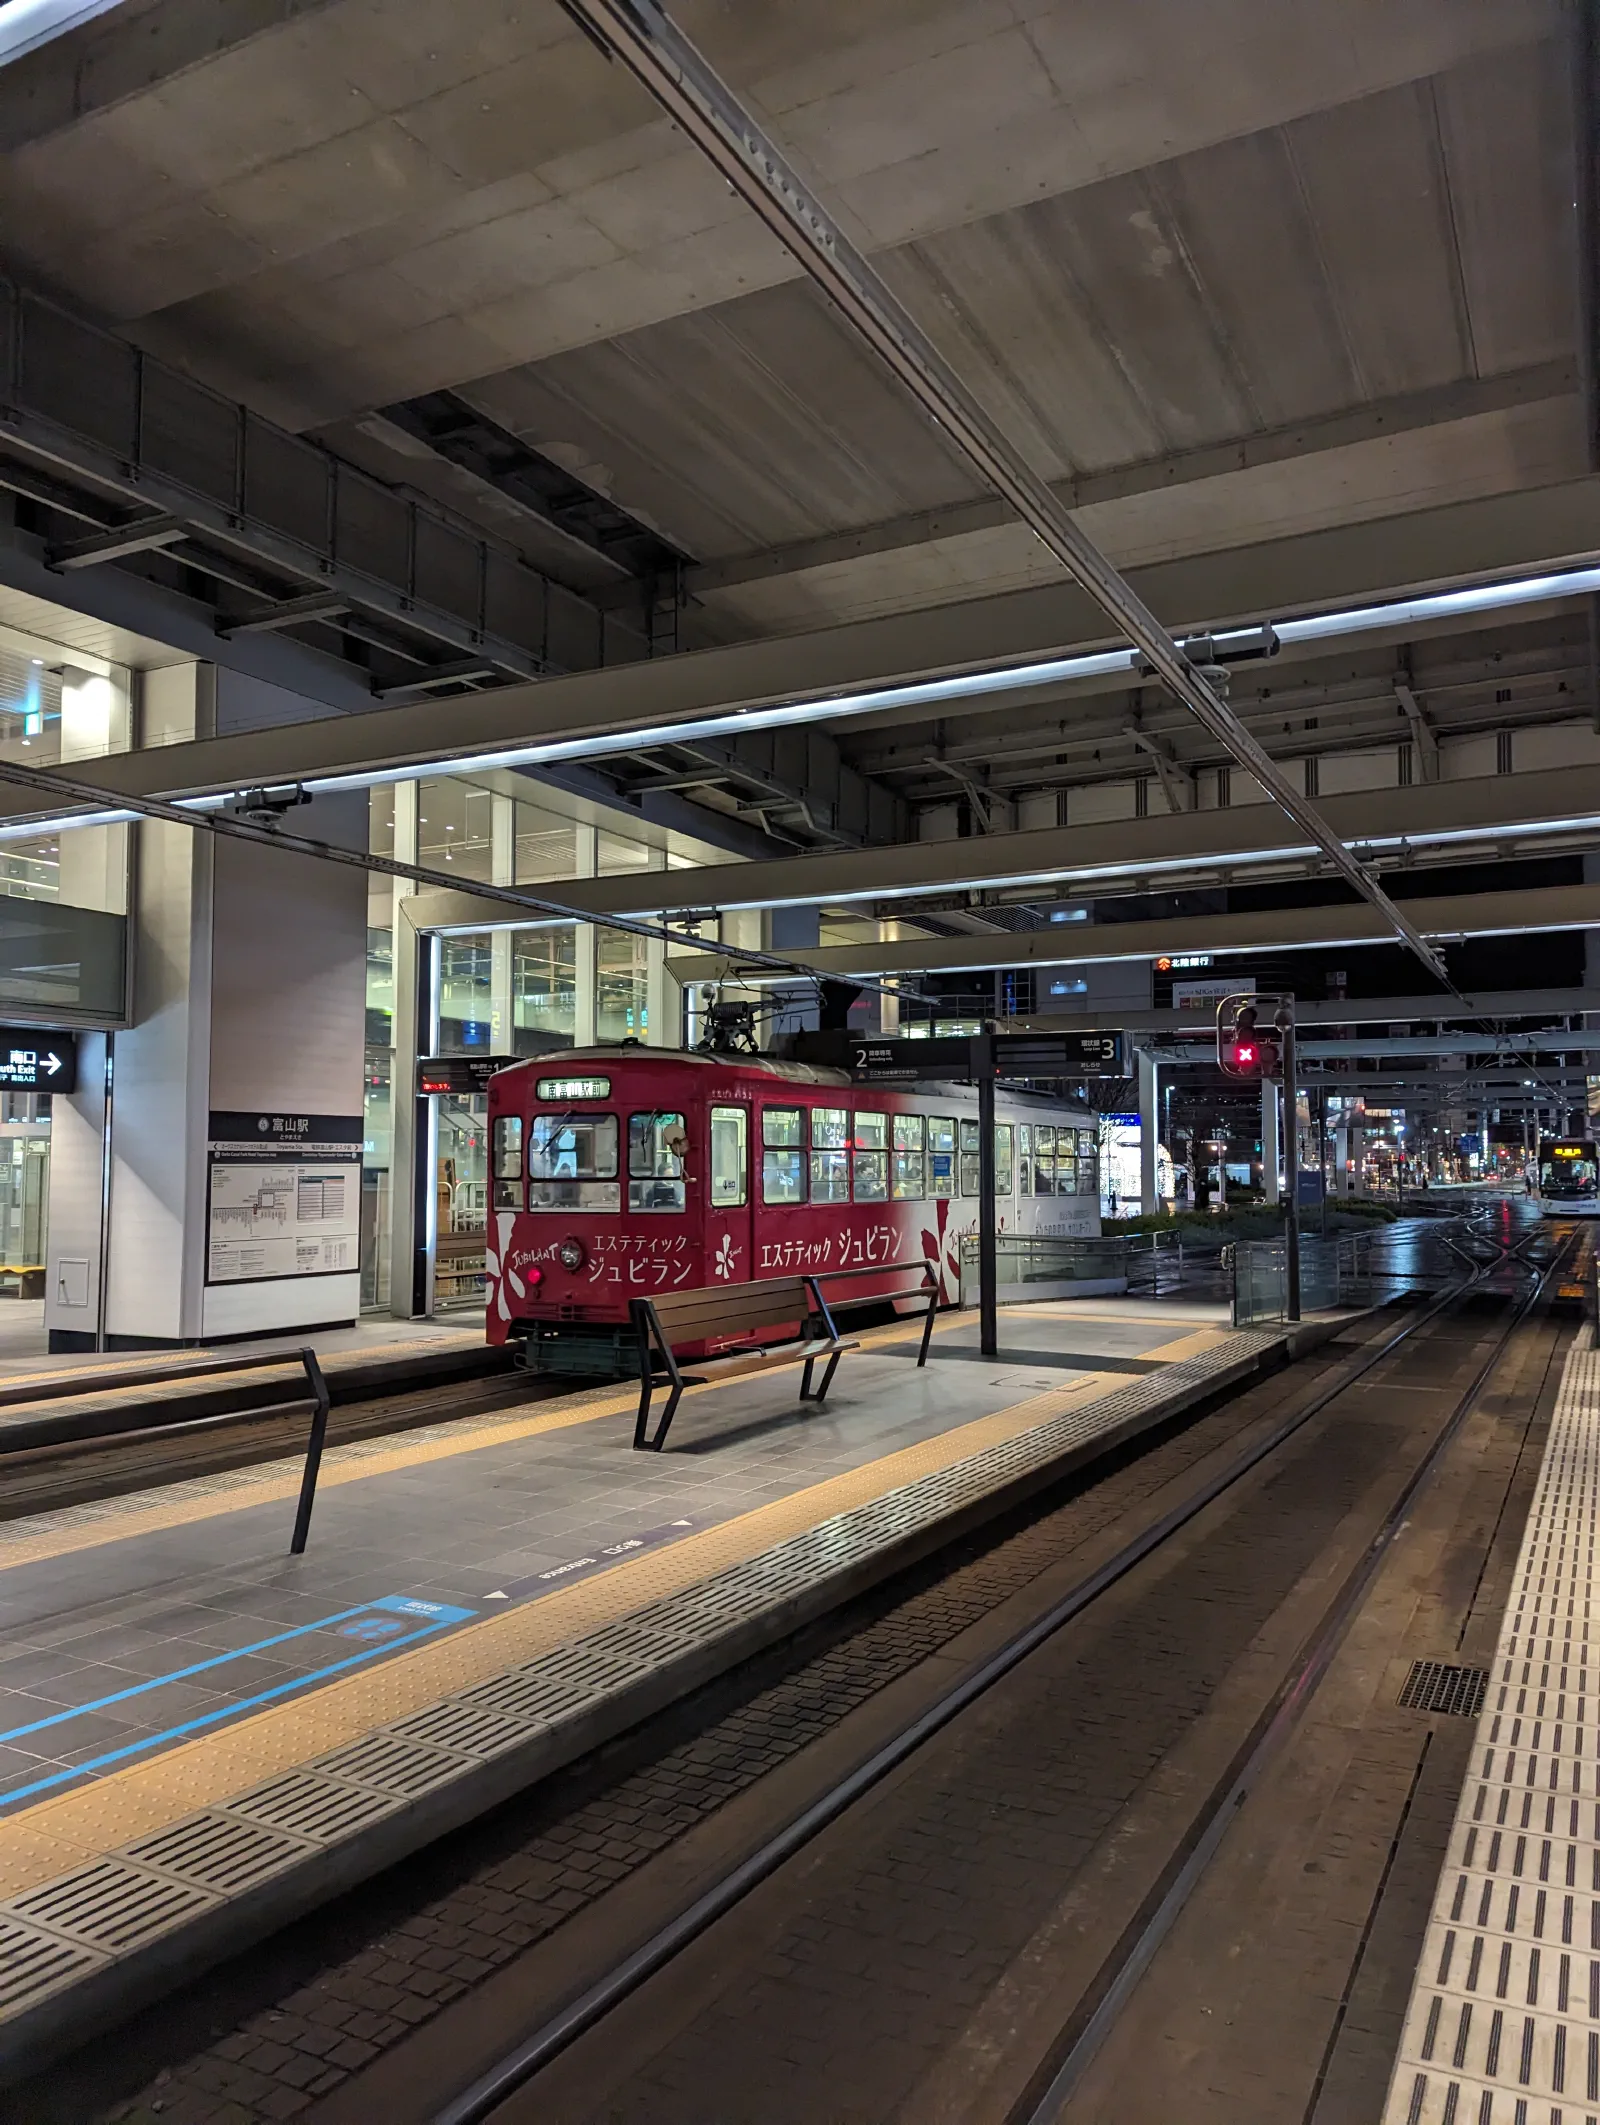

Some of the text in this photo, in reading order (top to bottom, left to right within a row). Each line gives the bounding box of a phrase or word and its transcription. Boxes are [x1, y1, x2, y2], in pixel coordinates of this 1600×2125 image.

[1171, 957, 1209, 968] 北陸銀行
[10, 1050, 36, 1064] 南口
[1101, 1039, 1114, 1059] 3
[856, 1050, 867, 1068] 2
[17, 1065, 36, 1074] Exit
[548, 1081, 600, 1099] 南富山駅前
[273, 1117, 309, 1132] 富山駅
[593, 1235, 687, 1252] エステティック
[760, 1225, 903, 1267] エステティック ジュビラン
[588, 1257, 692, 1285] ジュビラン
[538, 1557, 597, 1579] Entrance
